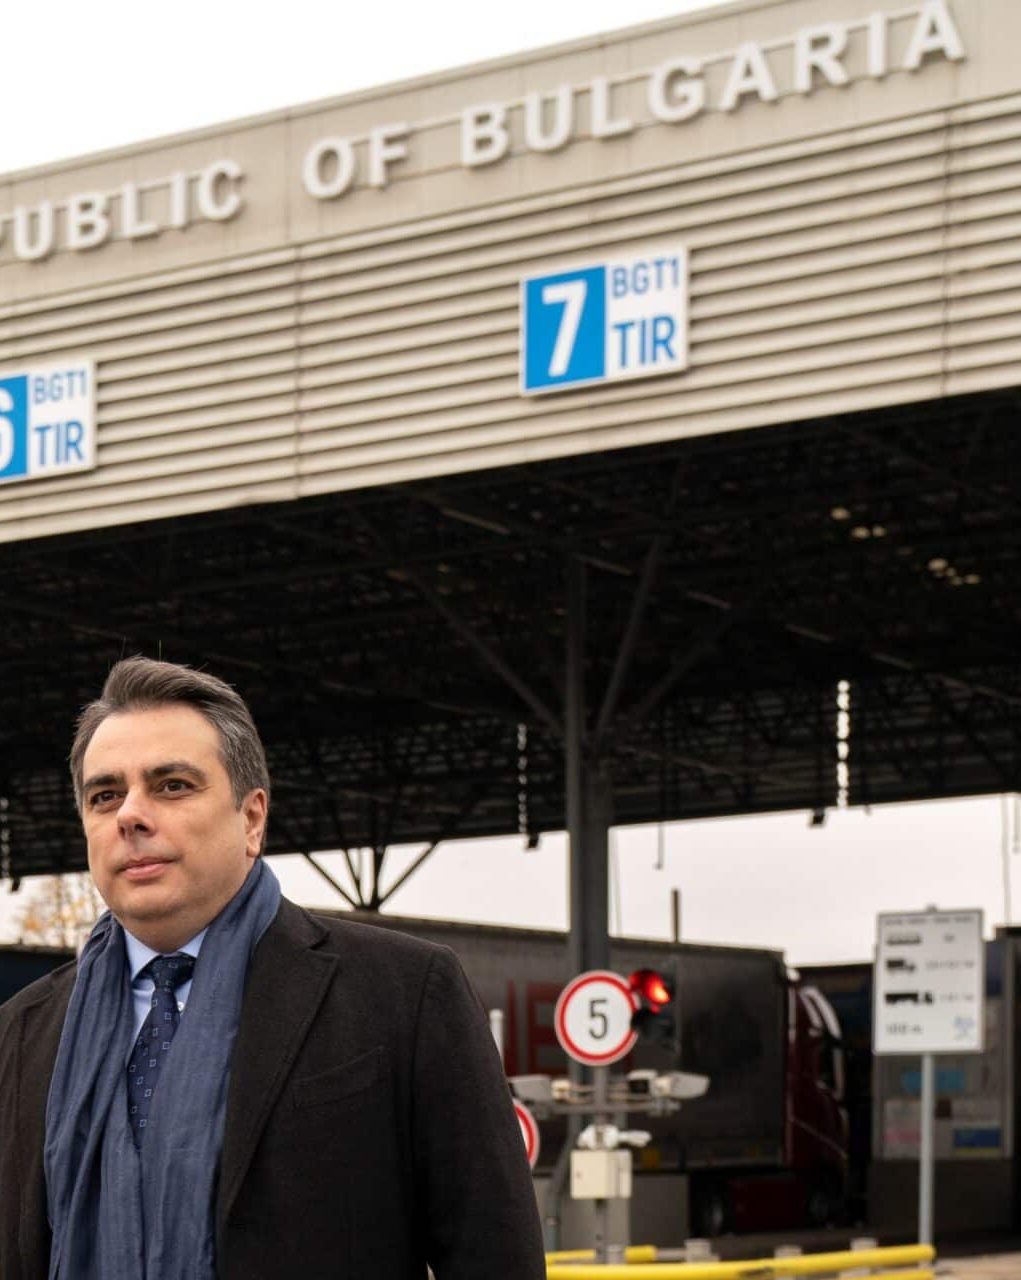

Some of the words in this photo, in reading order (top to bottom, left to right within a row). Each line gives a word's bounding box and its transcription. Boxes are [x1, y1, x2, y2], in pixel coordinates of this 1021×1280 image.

[302, 121, 410, 198] OF
[458, 0, 965, 168] BULGARIA
[611, 257, 679, 300] BGT1
[541, 277, 588, 379] 7
[611, 314, 678, 370] TIR
[33, 369, 87, 406] BGT1
[33, 419, 85, 468] TIR
[589, 998, 609, 1040] 5
